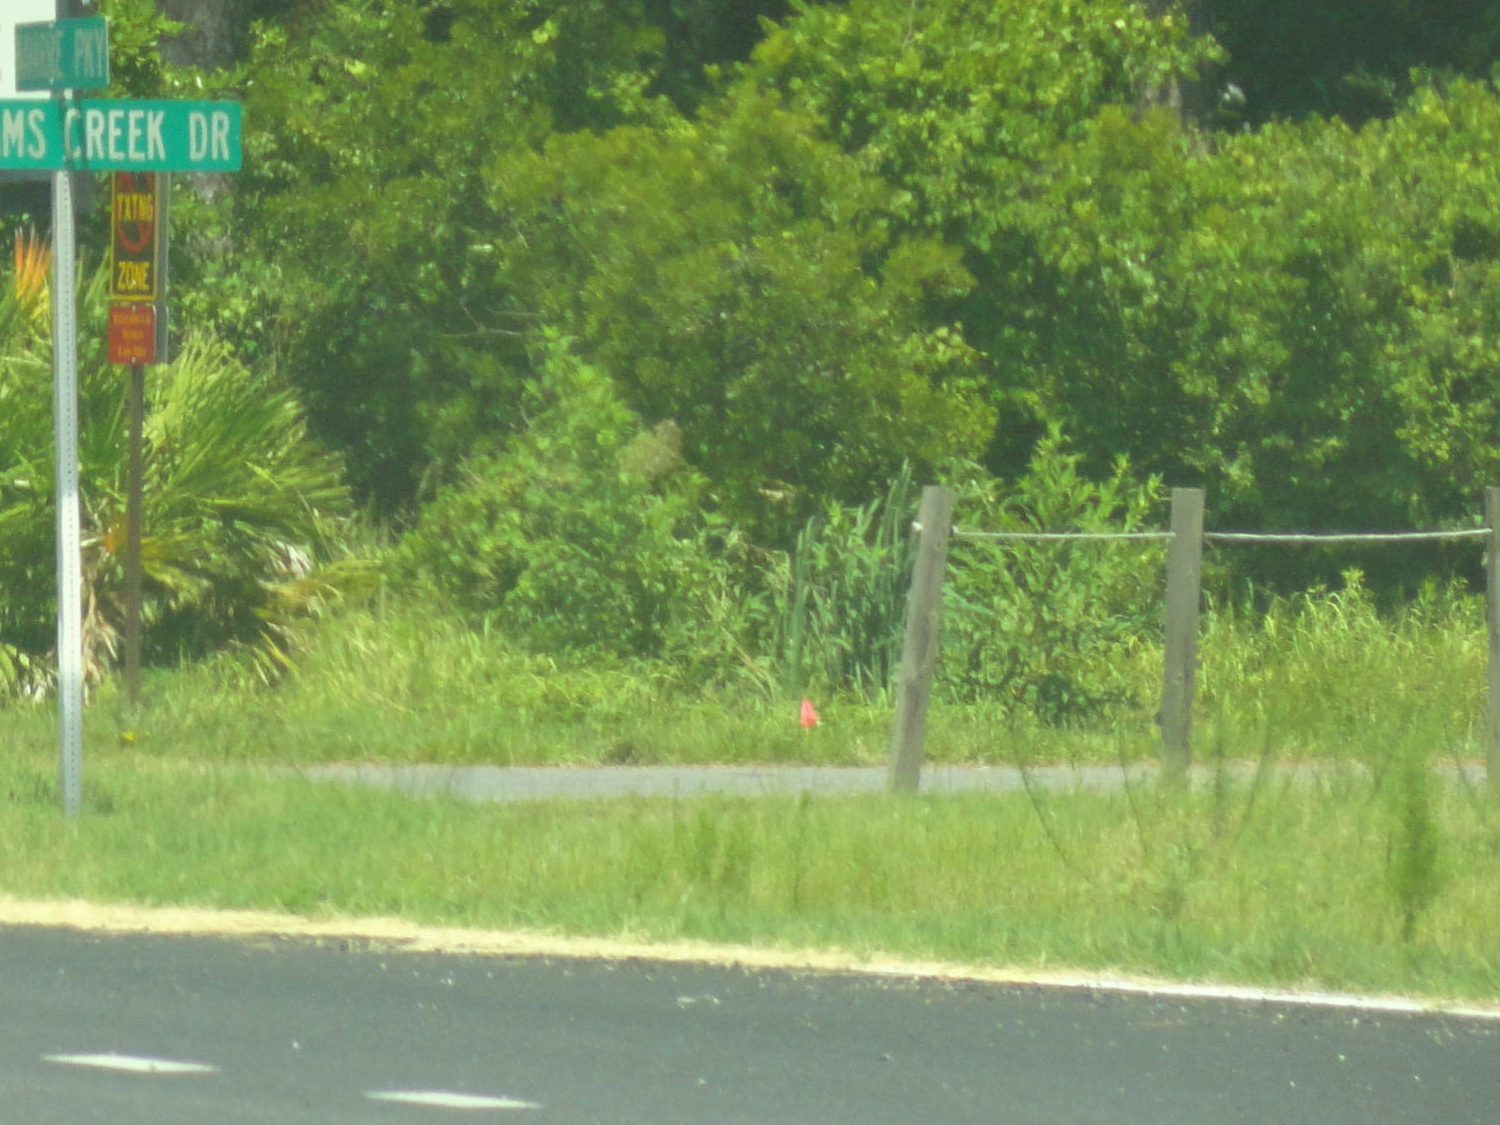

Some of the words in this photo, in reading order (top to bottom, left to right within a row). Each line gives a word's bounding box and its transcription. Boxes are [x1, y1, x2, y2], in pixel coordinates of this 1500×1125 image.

[63, 108, 167, 161] CREEK
[188, 110, 231, 161] DR
[117, 261, 150, 290] ZONE
